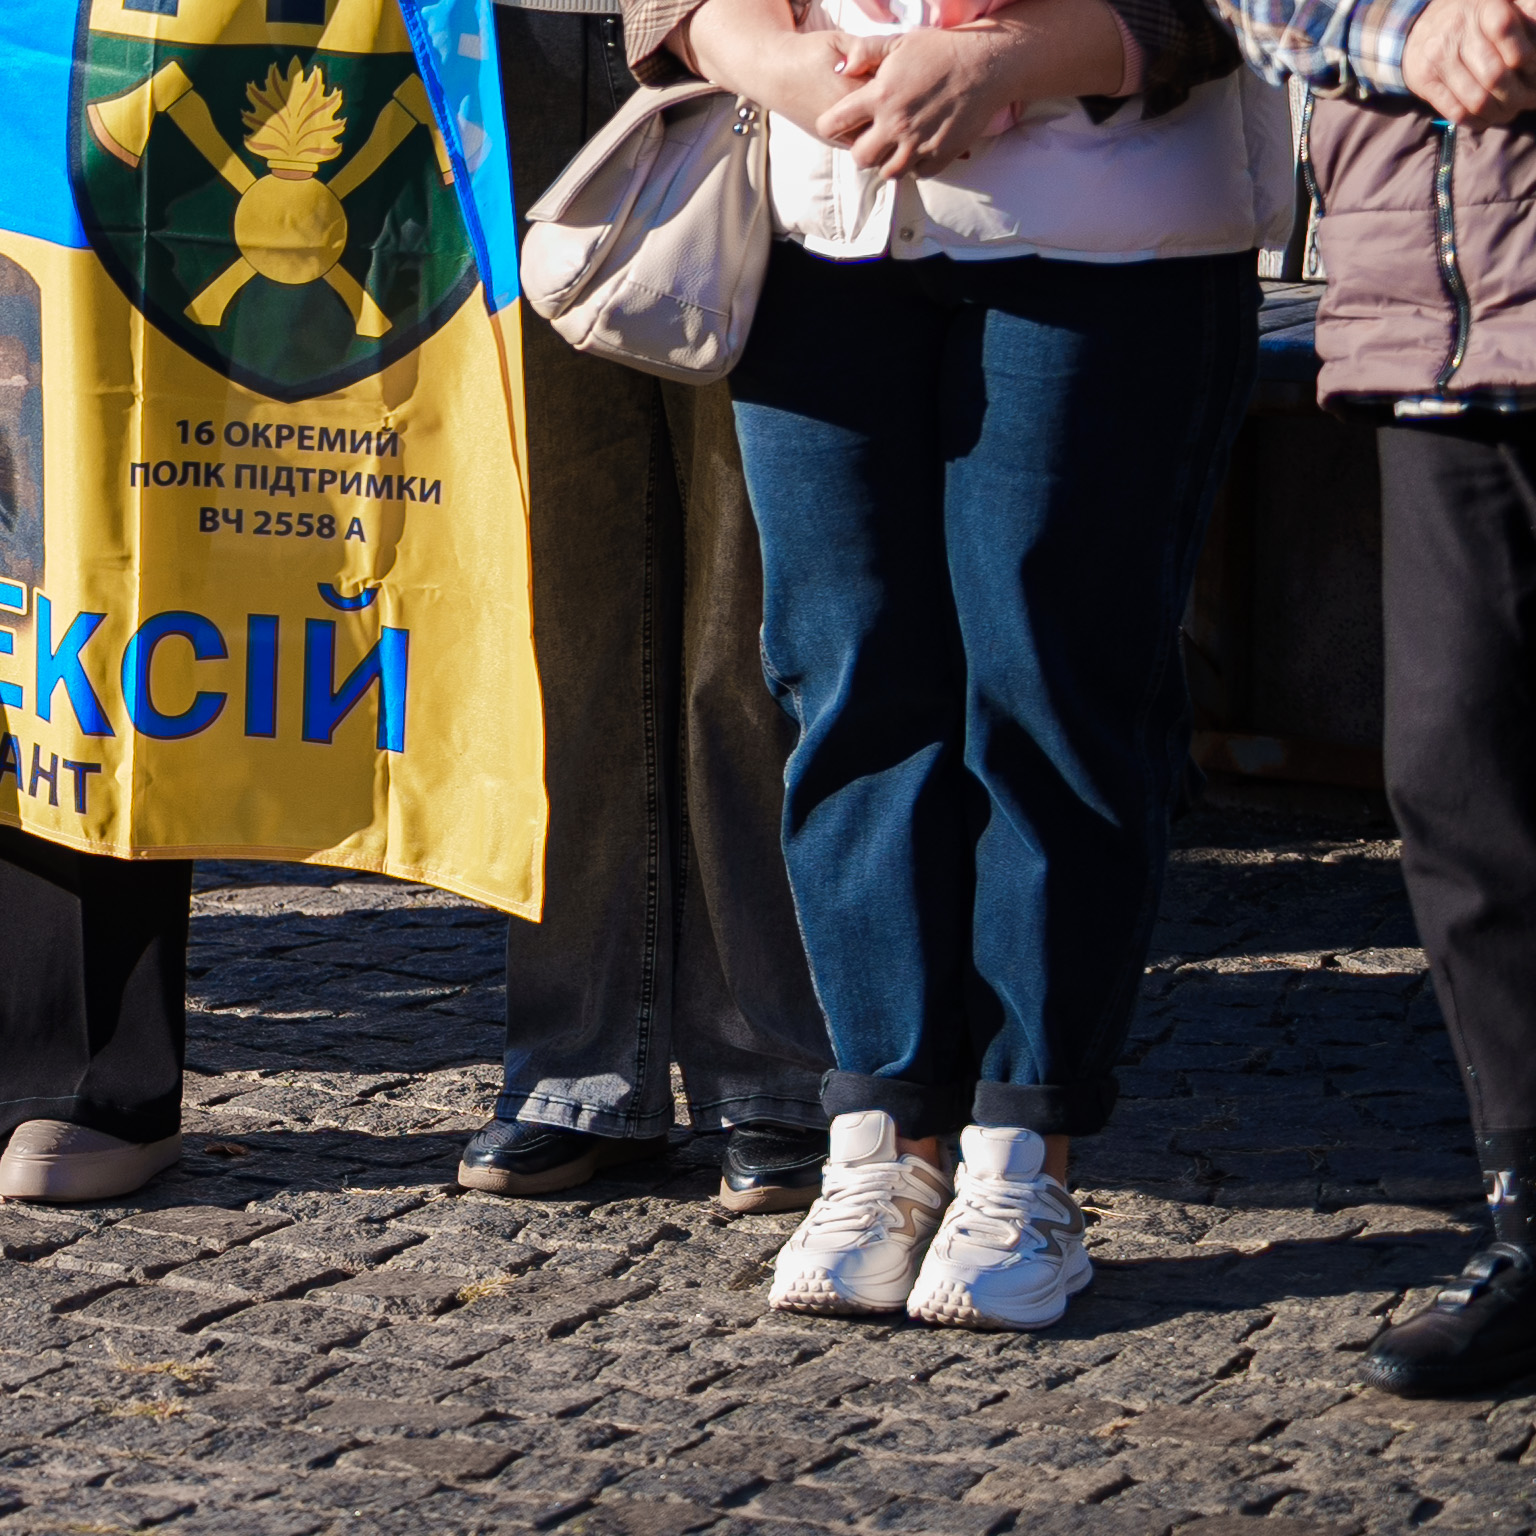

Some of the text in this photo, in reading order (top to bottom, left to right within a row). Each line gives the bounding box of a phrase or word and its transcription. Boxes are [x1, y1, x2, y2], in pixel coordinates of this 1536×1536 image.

[175, 419, 399, 457] 16 ОКРЕМИЙ
[130, 460, 443, 505] ПОЛК ПІДТРИМКИ
[198, 506, 367, 543] ВЧ 2558 А
